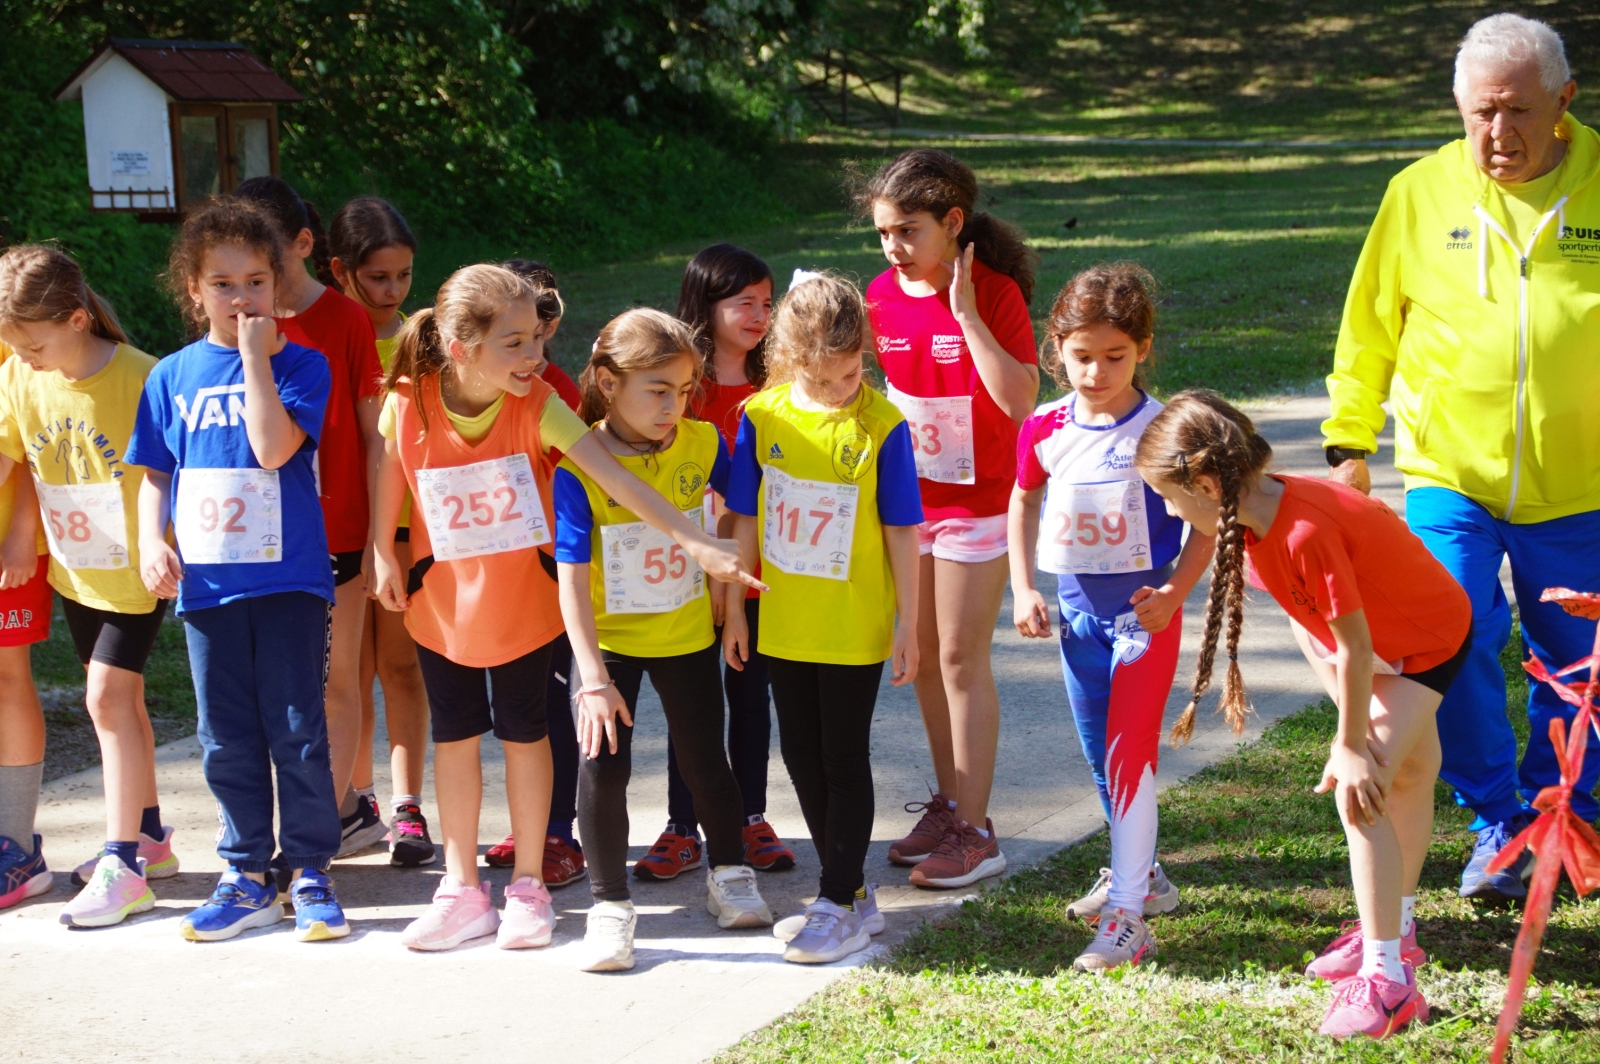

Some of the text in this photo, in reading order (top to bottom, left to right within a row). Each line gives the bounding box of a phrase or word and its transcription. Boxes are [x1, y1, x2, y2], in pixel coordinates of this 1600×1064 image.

[932, 334, 966, 345] PODISTIC
[1112, 462, 1135, 470] Cast
[1114, 454, 1134, 462] Atle
[49, 508, 91, 543] 58
[199, 496, 247, 533] 92
[442, 486, 523, 530] 252
[775, 501, 834, 547] 117
[1054, 511, 1128, 547] 259
[643, 543, 687, 585] 55
